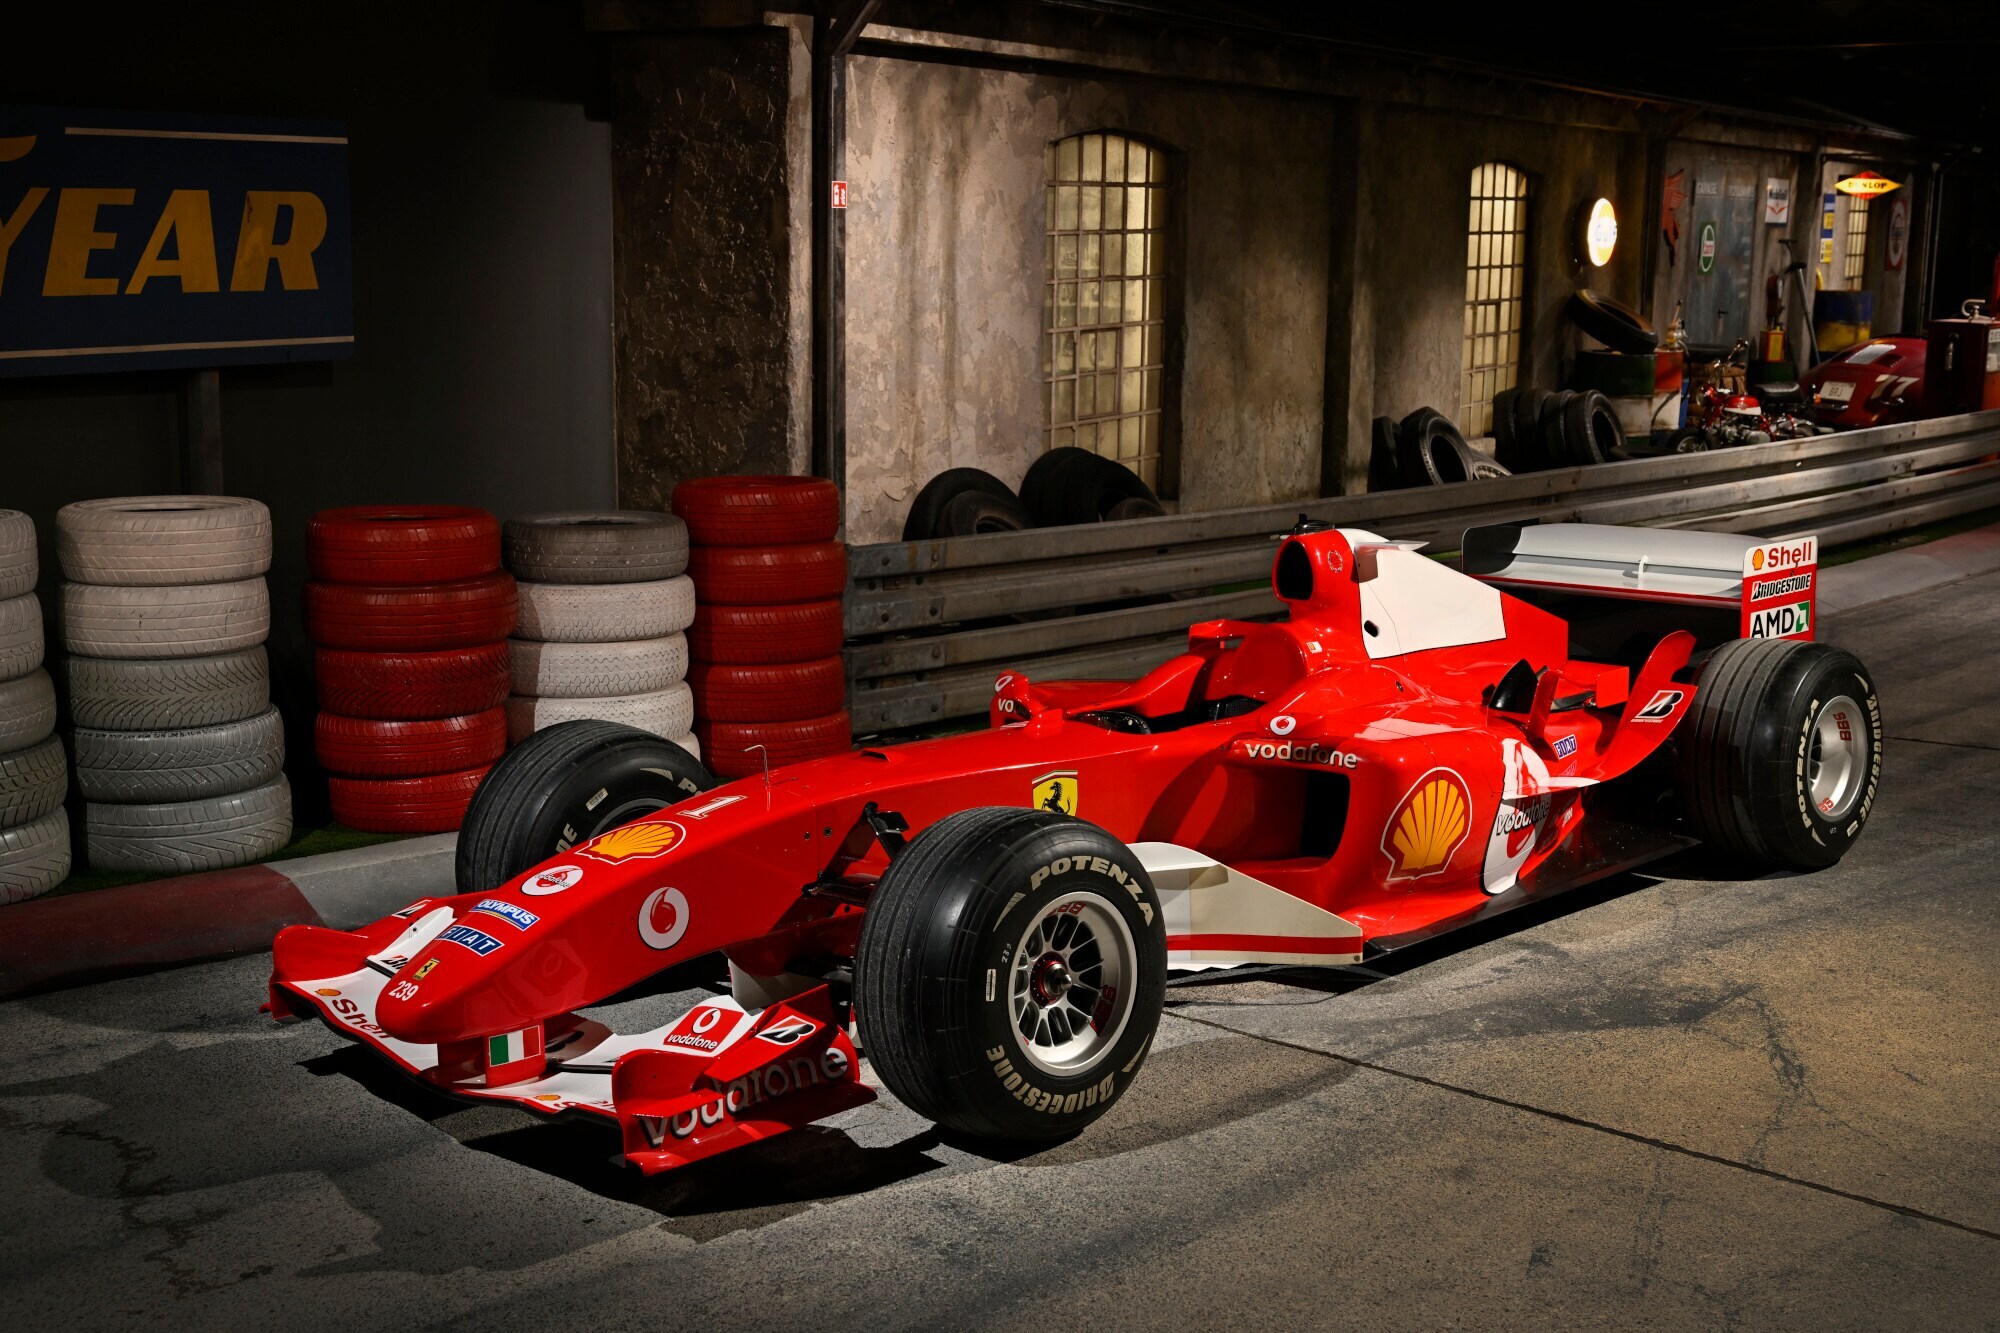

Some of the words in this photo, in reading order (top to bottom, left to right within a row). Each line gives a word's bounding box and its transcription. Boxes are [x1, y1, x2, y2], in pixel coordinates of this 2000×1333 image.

[1870, 374, 1920, 400] 77
[1768, 541, 1812, 567] Shell
[1751, 572, 1812, 601] BRIDGESTONE
[1751, 607, 1795, 639] AMD
[1833, 711, 1852, 741] BBS
[1246, 740, 1358, 769] vodafone
[1556, 738, 1576, 757] FIAT
[1859, 694, 1882, 823] BRIDGESTONE
[1031, 855, 1154, 927] POTENZA
[477, 900, 537, 926] OLYMPUS
[445, 926, 497, 952] FIAT
[388, 980, 419, 1002] 239
[667, 1033, 718, 1050] vodafone
[986, 1044, 1115, 1115] BRIDGESTONE
[641, 1047, 849, 1148] vodafone
